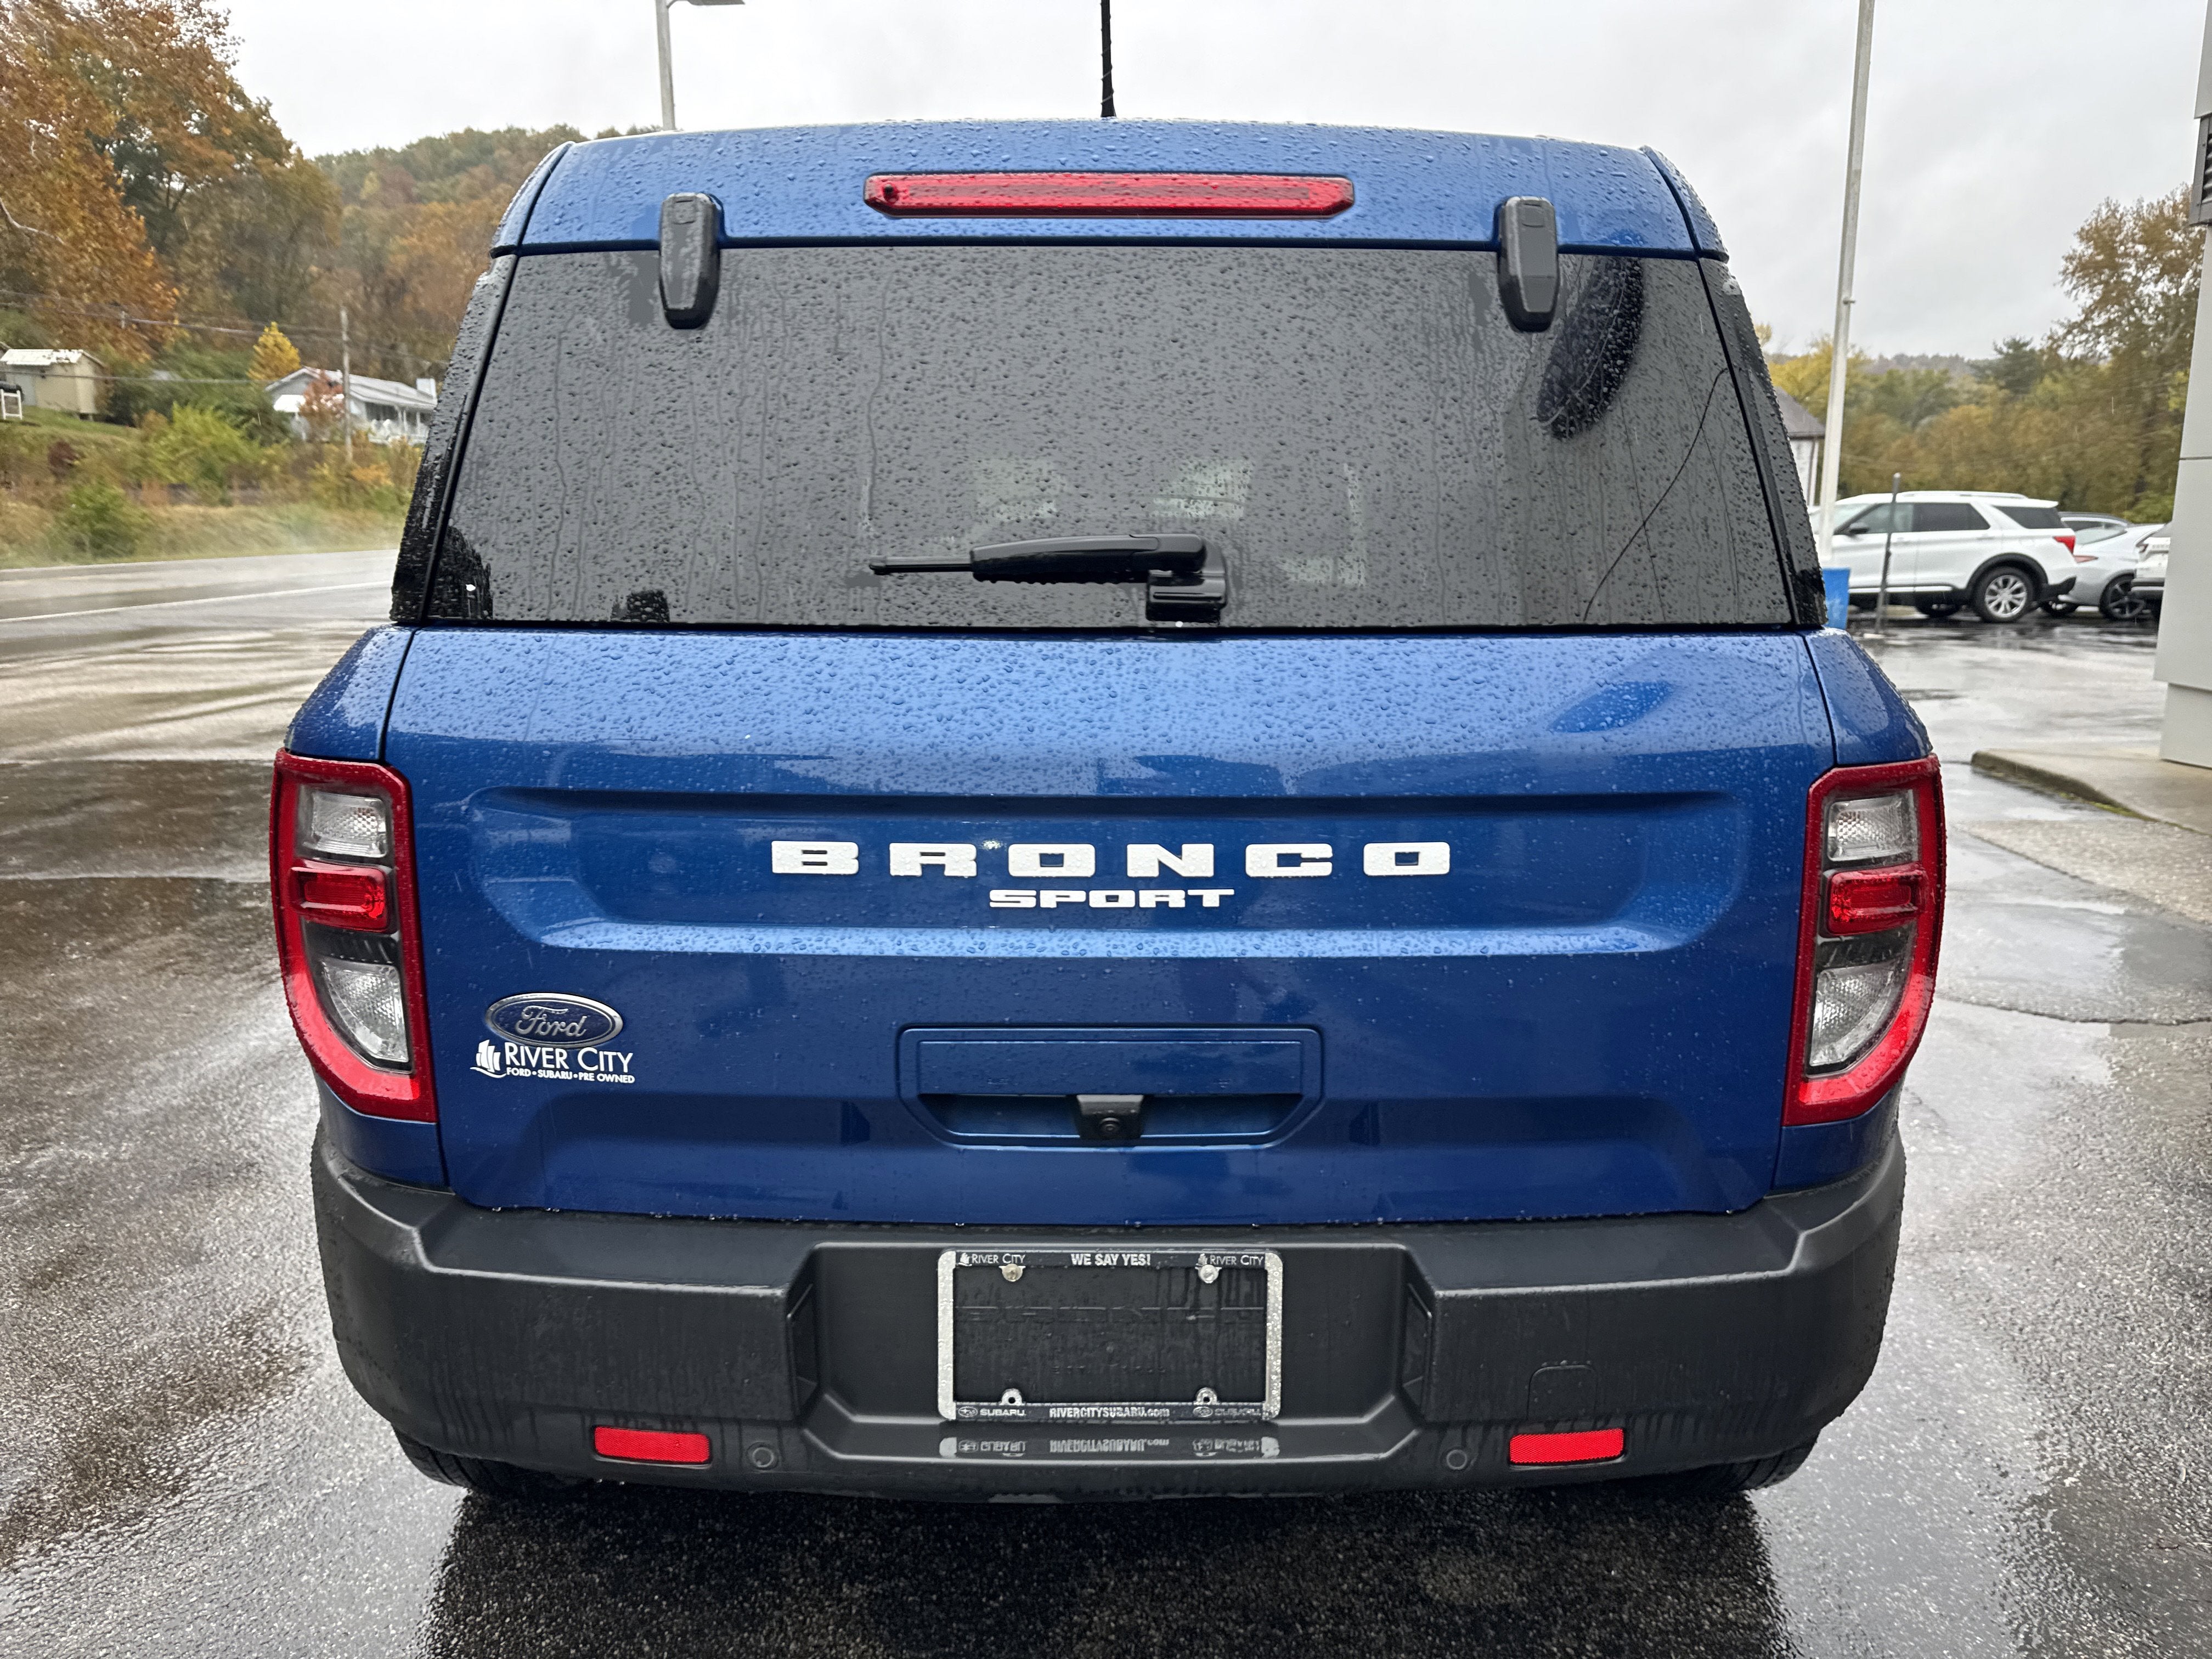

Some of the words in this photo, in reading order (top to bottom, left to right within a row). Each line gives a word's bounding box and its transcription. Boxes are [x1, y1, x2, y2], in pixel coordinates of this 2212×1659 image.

[771, 840, 1451, 878] BRONCO
[989, 889, 1235, 909] SPORT
[515, 1005, 588, 1037] Ford
[504, 1042, 569, 1069] RIVER
[577, 1047, 634, 1073] CITY
[596, 1073, 635, 1084] OWNED
[972, 1253, 999, 1264] RIVER
[1002, 1253, 1026, 1264] CITY
[1070, 1253, 1092, 1266] WE
[1094, 1253, 1119, 1266] SAY
[1121, 1253, 1151, 1266] YES!
[1210, 1254, 1237, 1266] RIVER
[1240, 1255, 1264, 1266] CITY
[979, 1408, 1025, 1417] SUBARU
